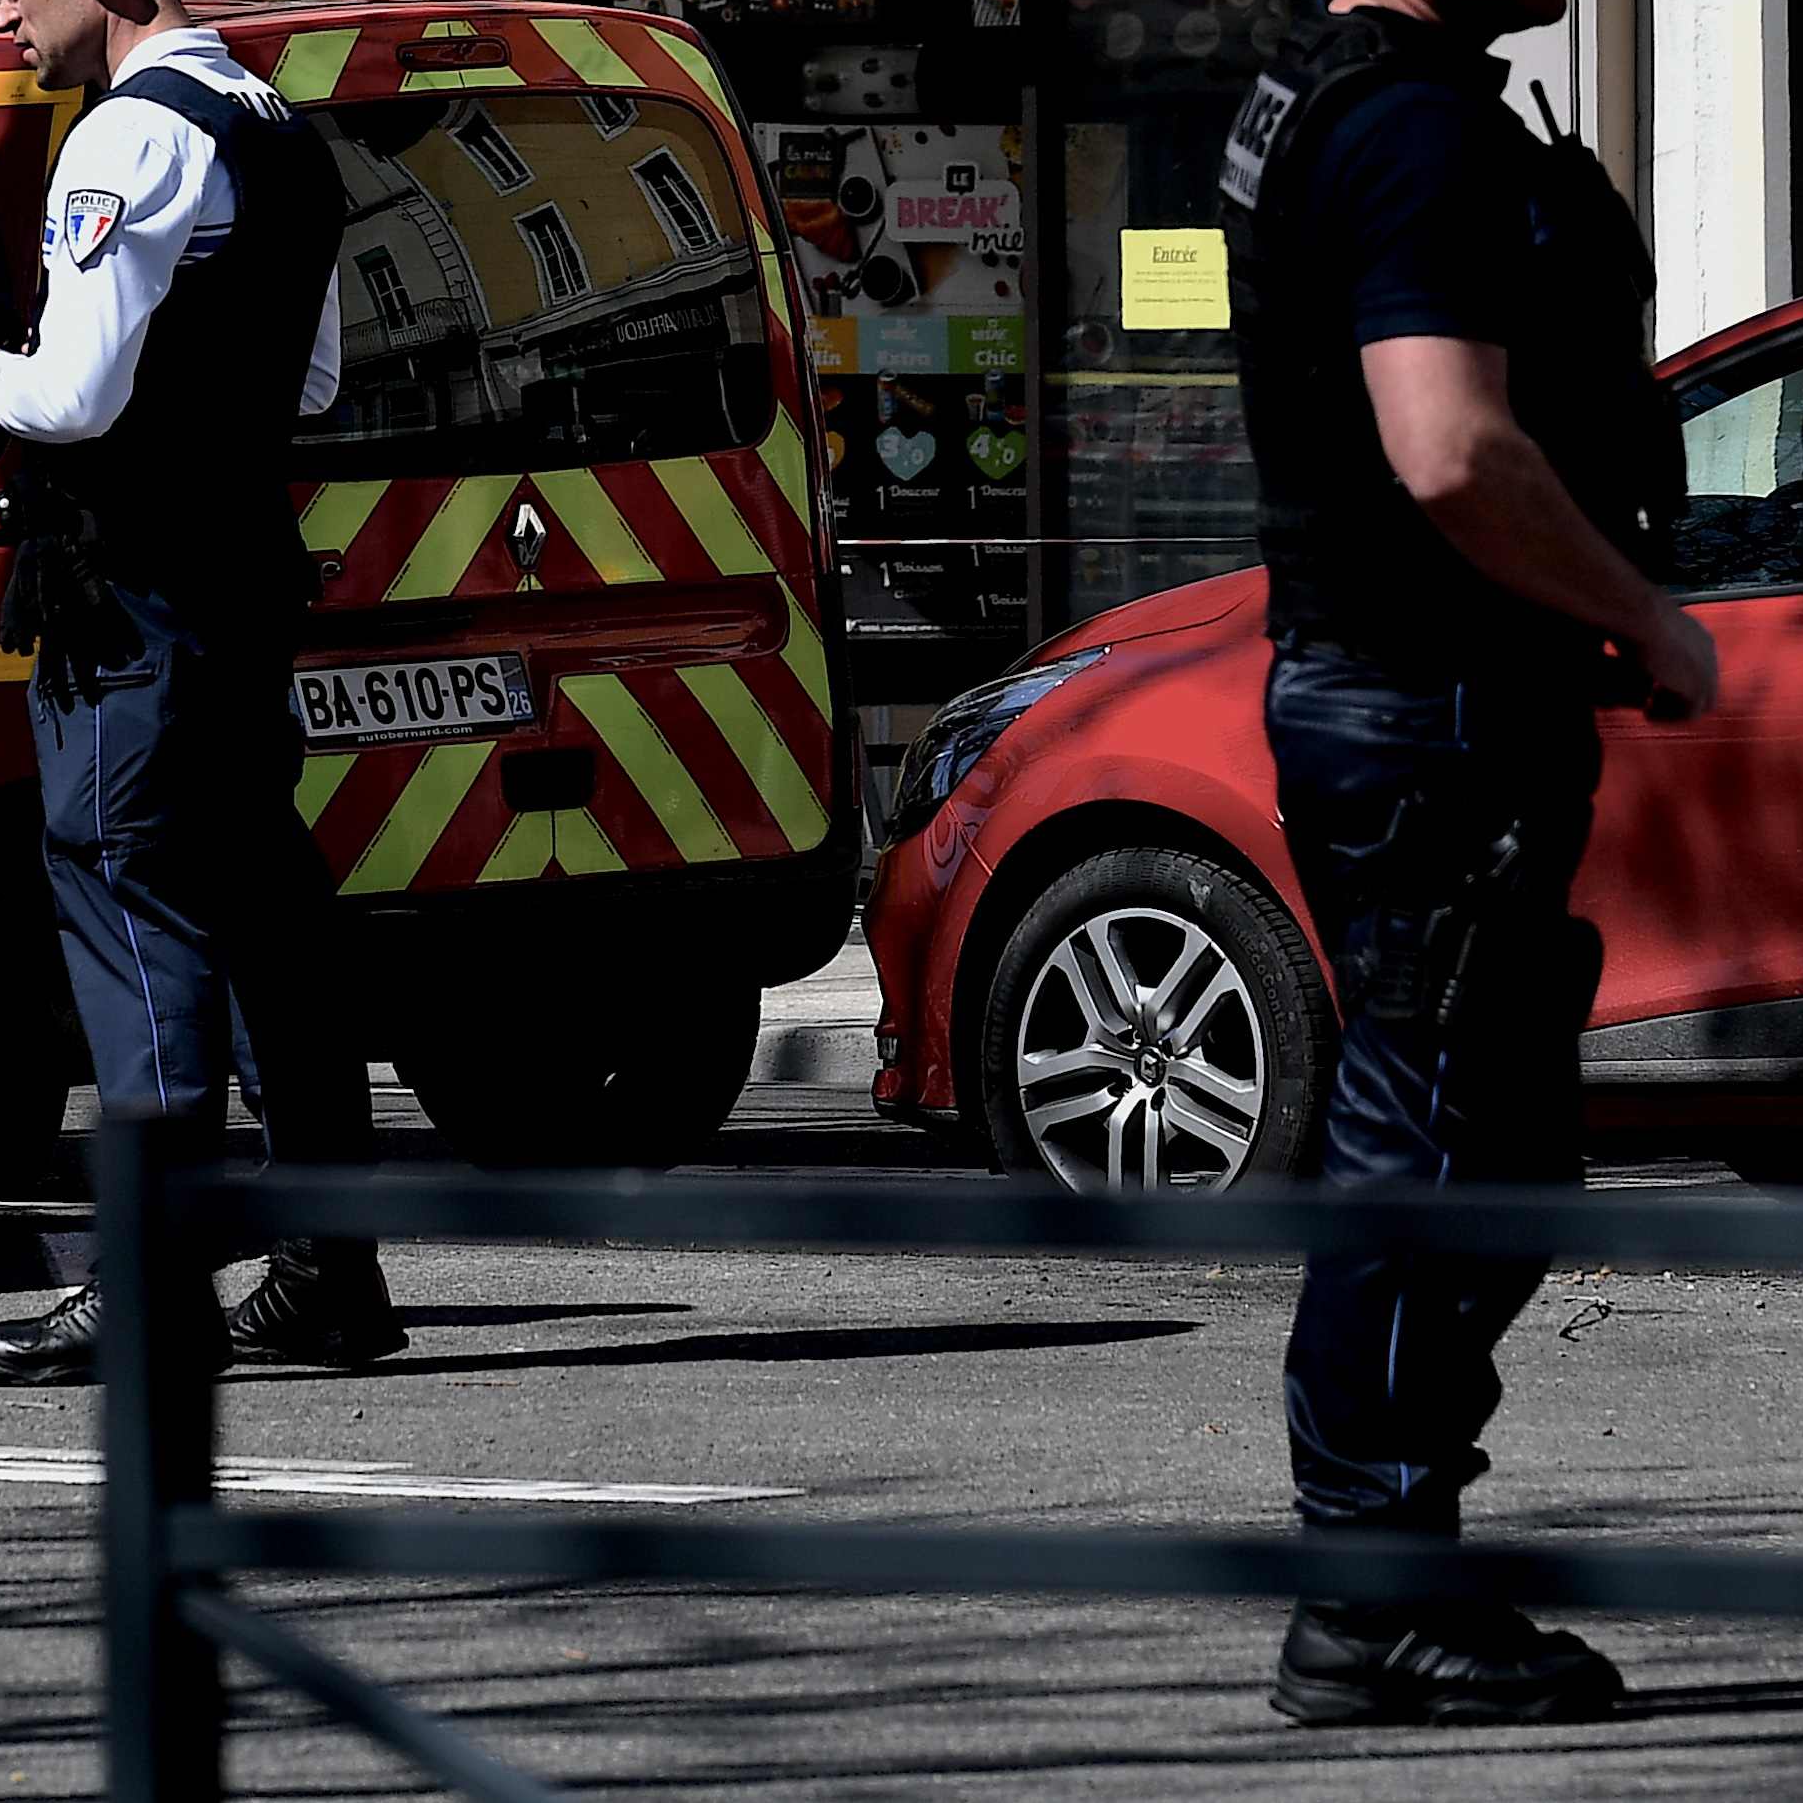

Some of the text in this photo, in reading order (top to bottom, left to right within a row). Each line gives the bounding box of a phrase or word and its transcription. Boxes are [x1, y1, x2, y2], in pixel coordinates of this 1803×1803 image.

[1152, 244, 1198, 264] Entrée
[508, 690, 532, 716] 26
[357, 724, 473, 743] autobernard.com
